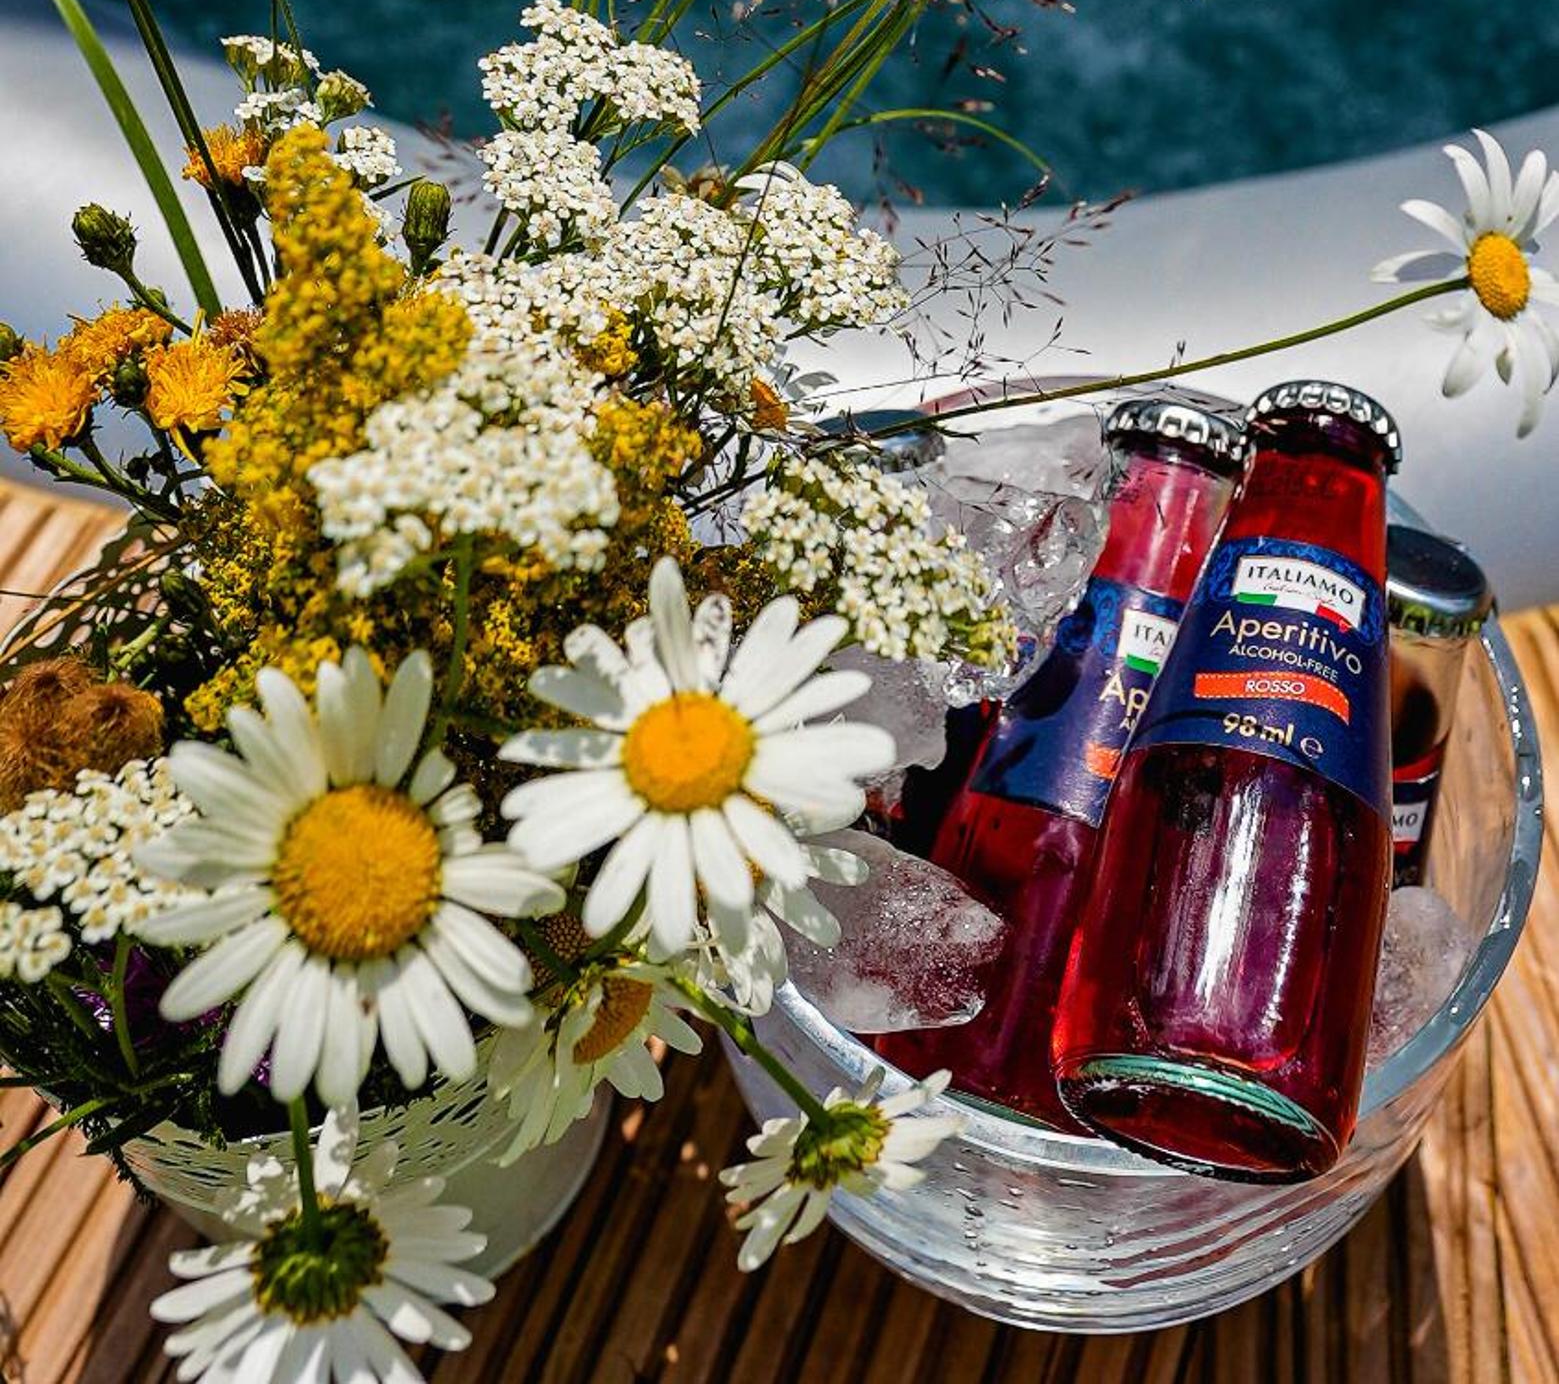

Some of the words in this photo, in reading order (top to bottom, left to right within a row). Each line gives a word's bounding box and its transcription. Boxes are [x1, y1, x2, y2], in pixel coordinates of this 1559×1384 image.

[1247, 566, 1354, 605] ITALIAMO
[1210, 610, 1362, 675] Aperitivo
[1228, 644, 1339, 684] ALCOHOL-FREE
[1245, 679, 1306, 695] ROSSO
